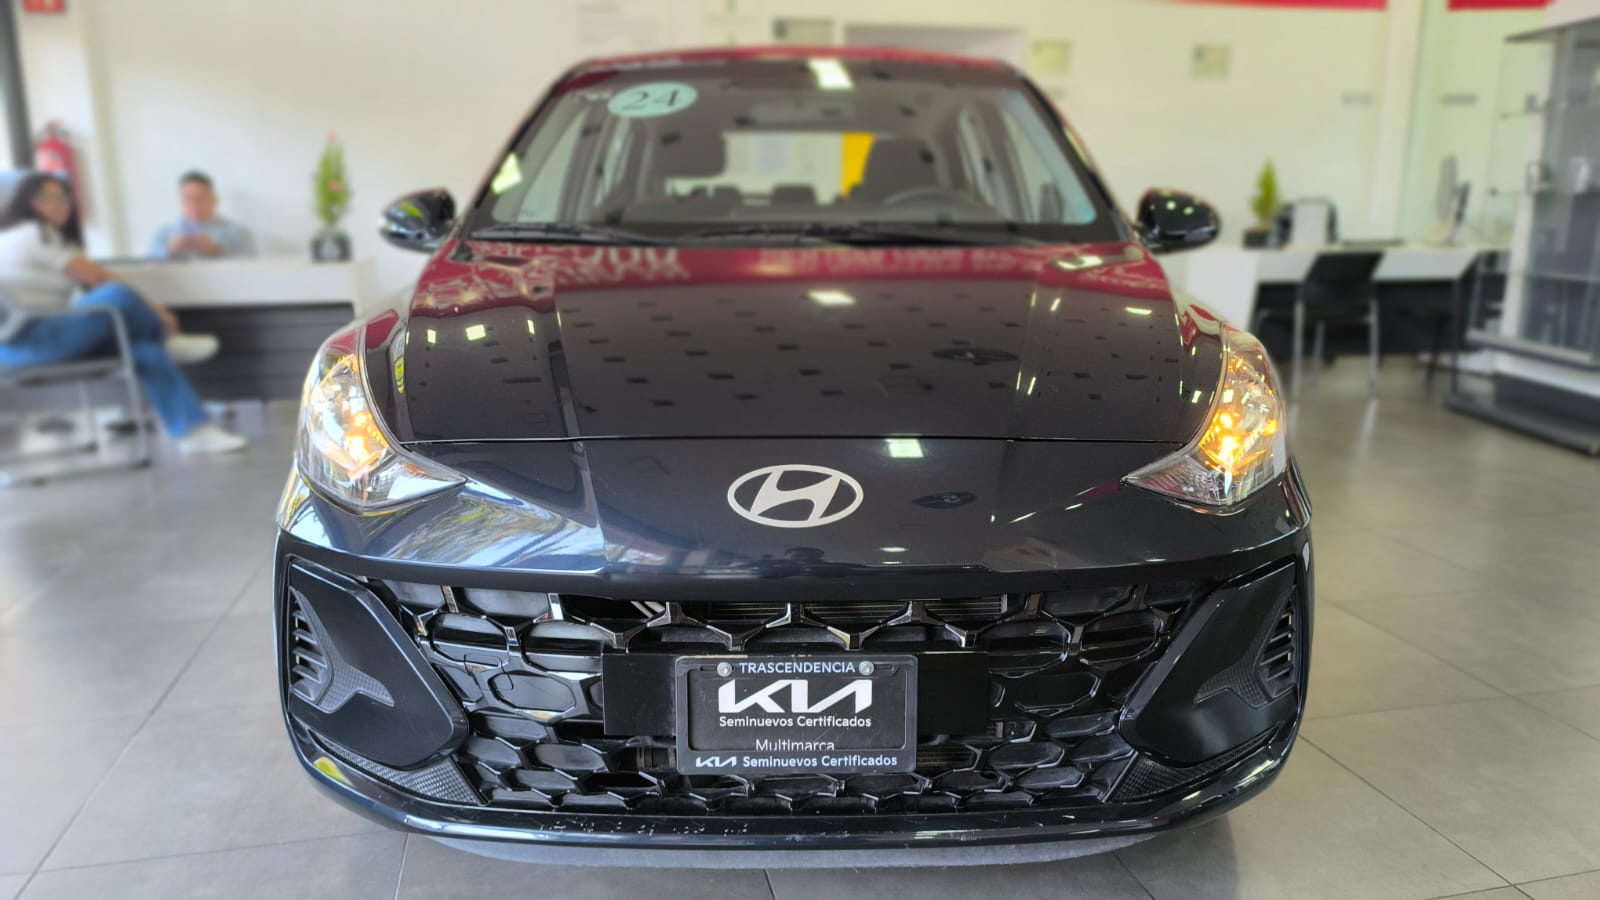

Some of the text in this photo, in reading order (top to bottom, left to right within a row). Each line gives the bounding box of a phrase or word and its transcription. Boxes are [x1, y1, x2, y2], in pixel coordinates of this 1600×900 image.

[739, 662, 856, 674] TRASCENDENCIA
[718, 679, 873, 714] KIA
[719, 715, 872, 728] Seminuevos Certificados
[755, 738, 835, 751] Multimarca
[696, 755, 898, 768] KIA Seminuevos Certificados
